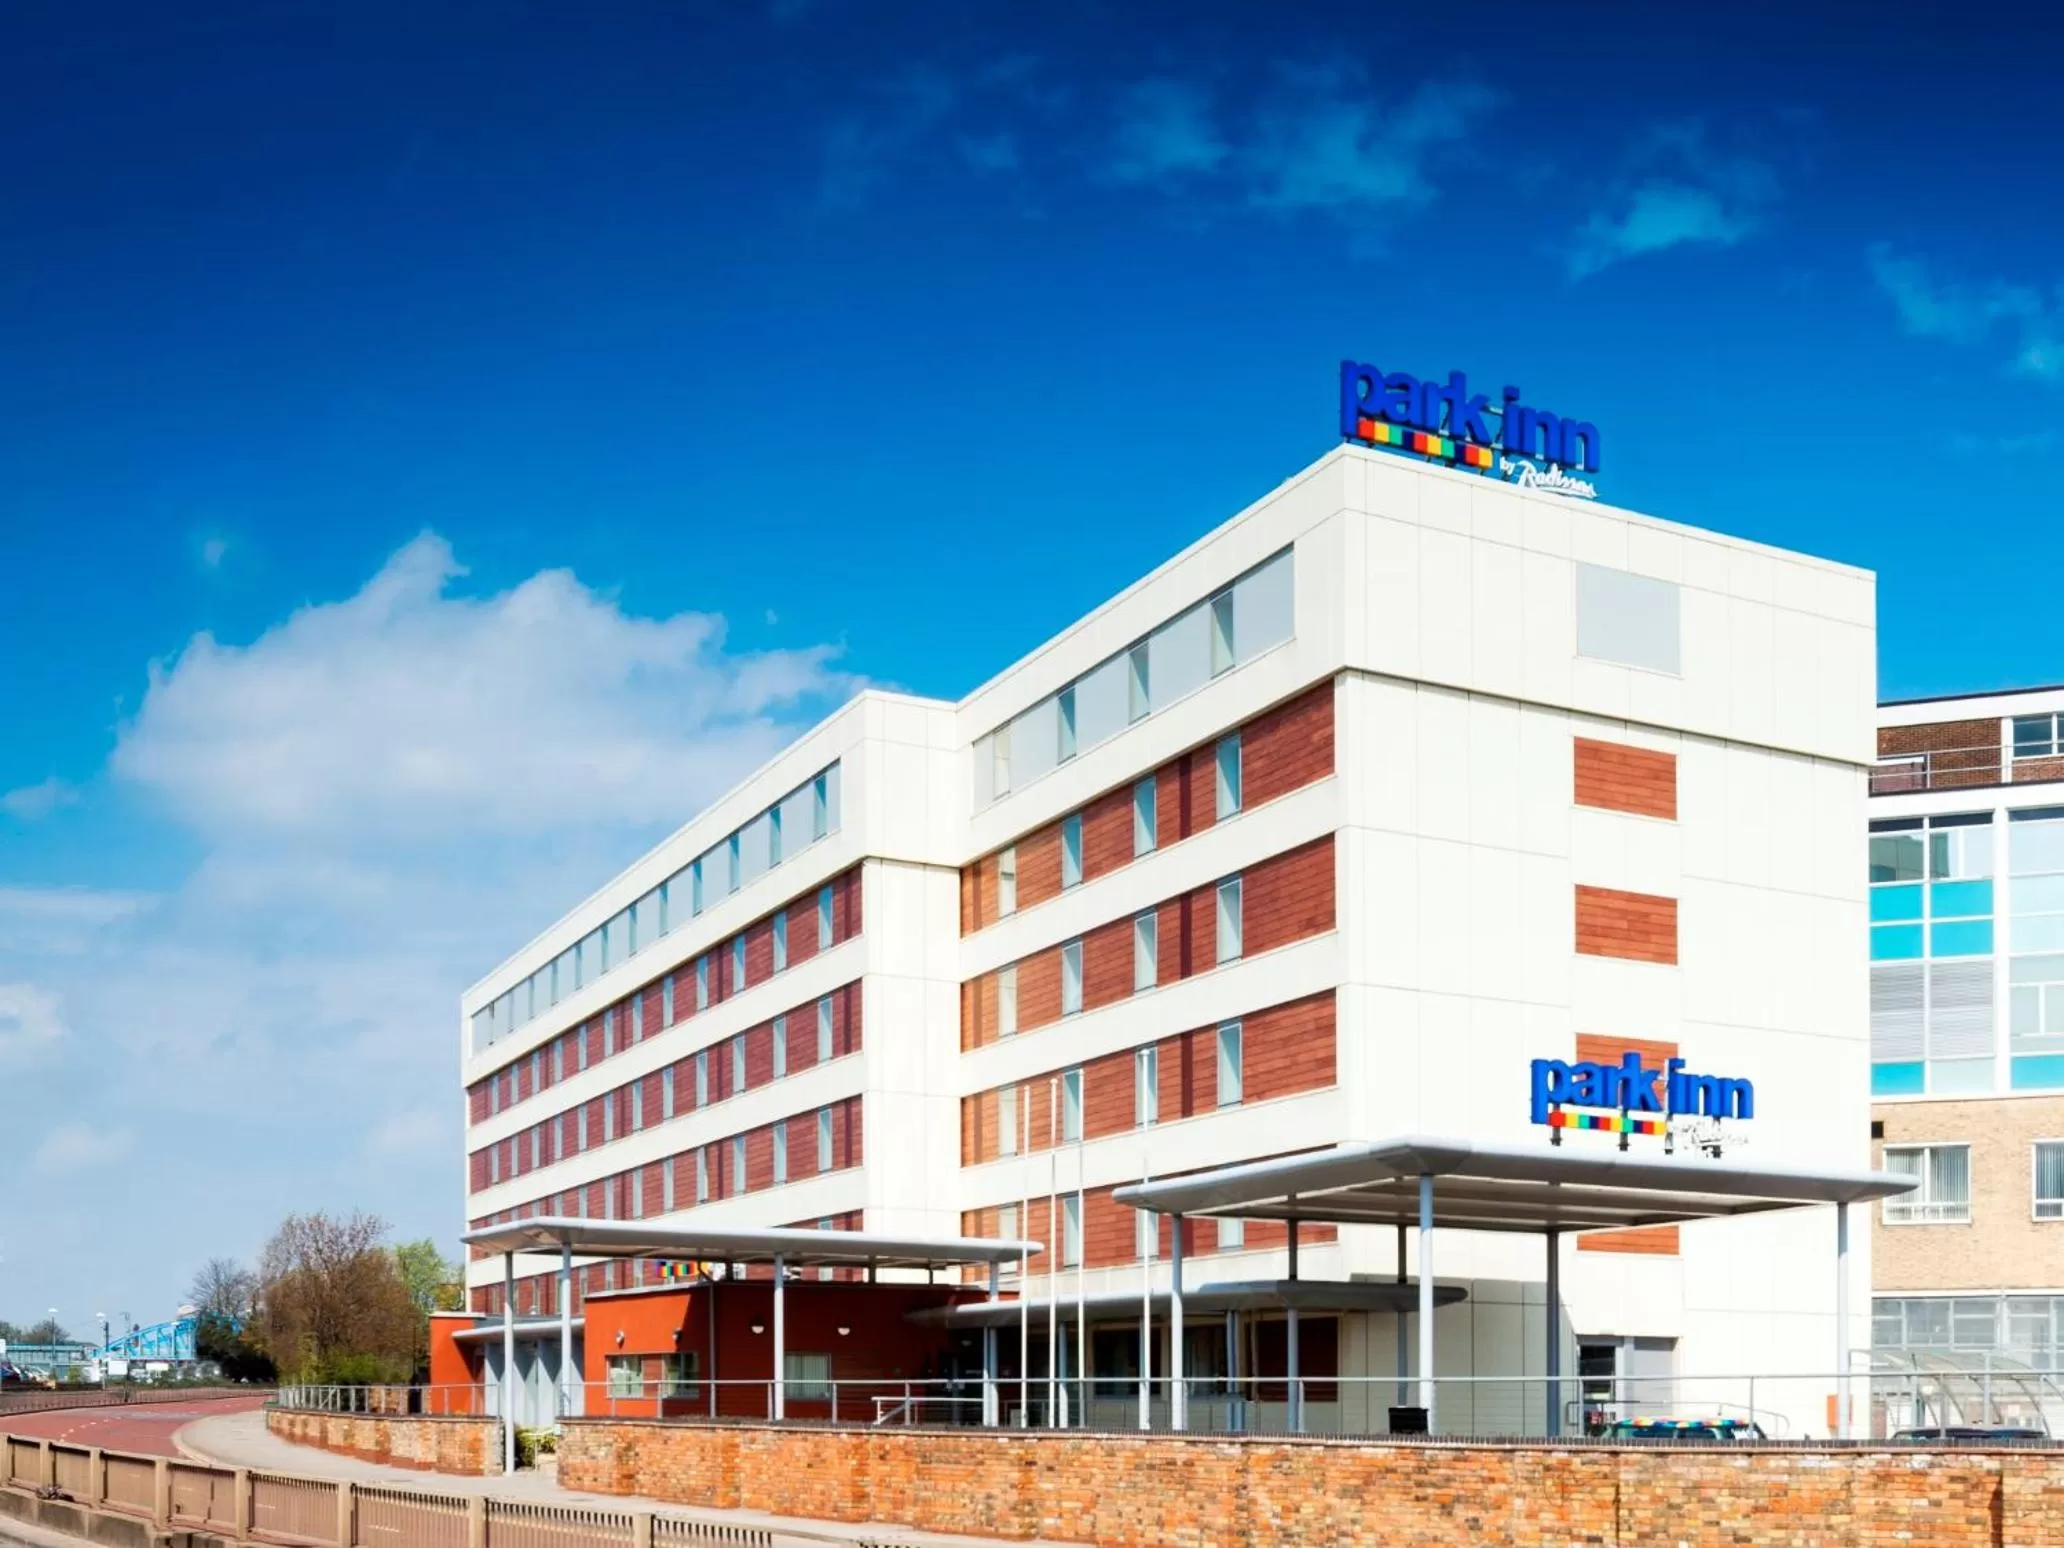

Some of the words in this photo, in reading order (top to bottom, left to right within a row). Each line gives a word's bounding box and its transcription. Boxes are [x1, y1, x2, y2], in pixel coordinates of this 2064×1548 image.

[1340, 360, 1492, 448] park
[1503, 385, 1600, 473] inn
[1530, 1052, 1664, 1125] park
[1668, 1057, 1755, 1120] inn
